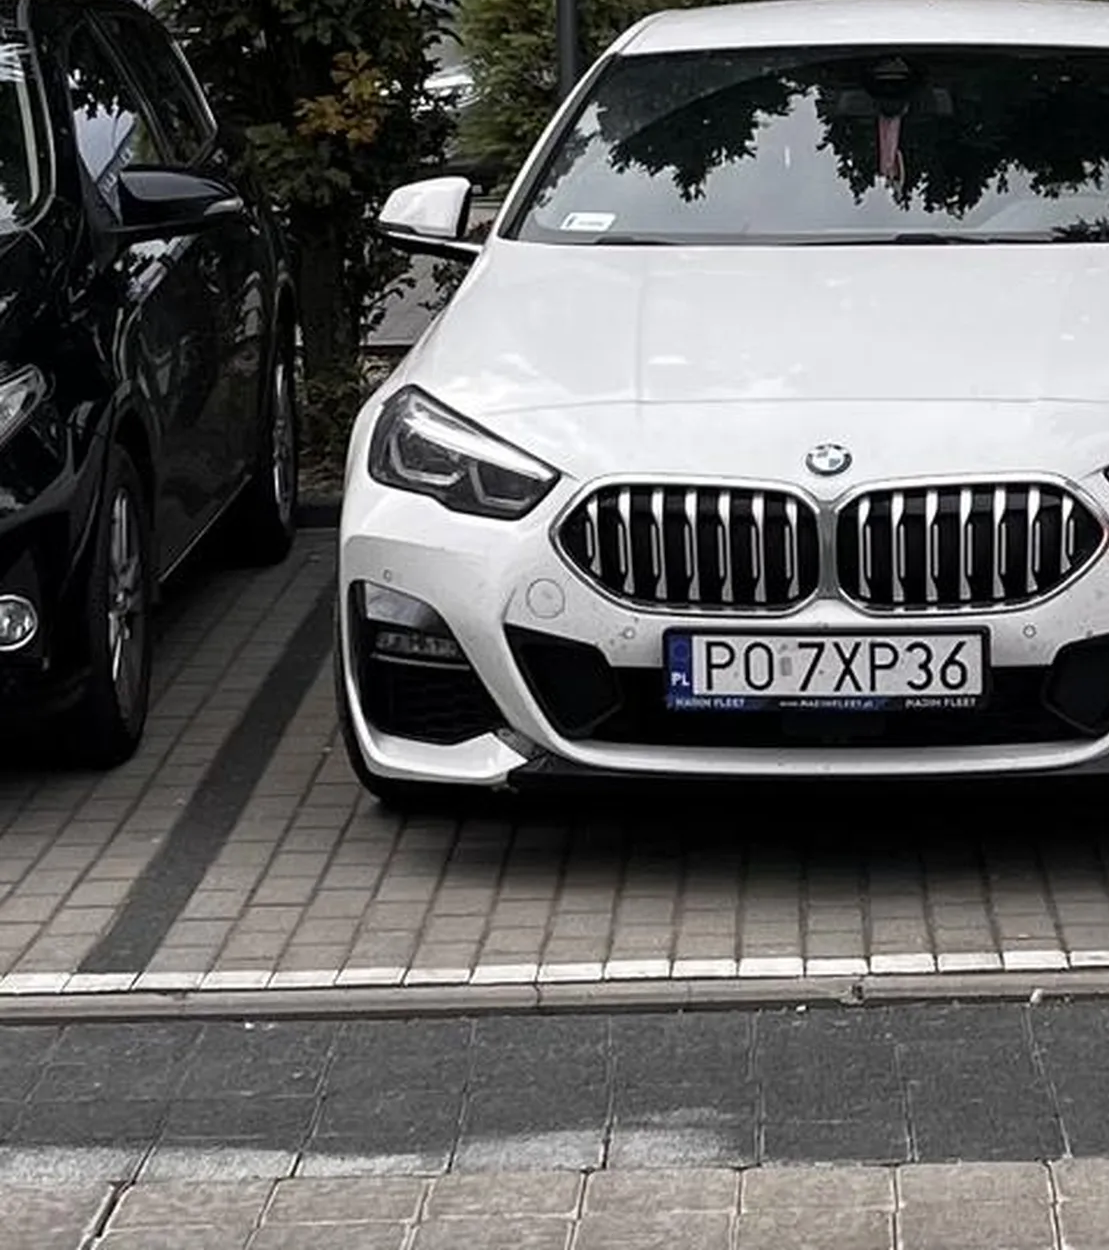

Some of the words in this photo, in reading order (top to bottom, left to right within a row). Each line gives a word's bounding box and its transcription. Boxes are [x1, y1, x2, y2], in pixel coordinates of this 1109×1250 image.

[671, 672, 690, 686] PL
[705, 641, 774, 691] PO
[798, 641, 968, 692] 7XP36
